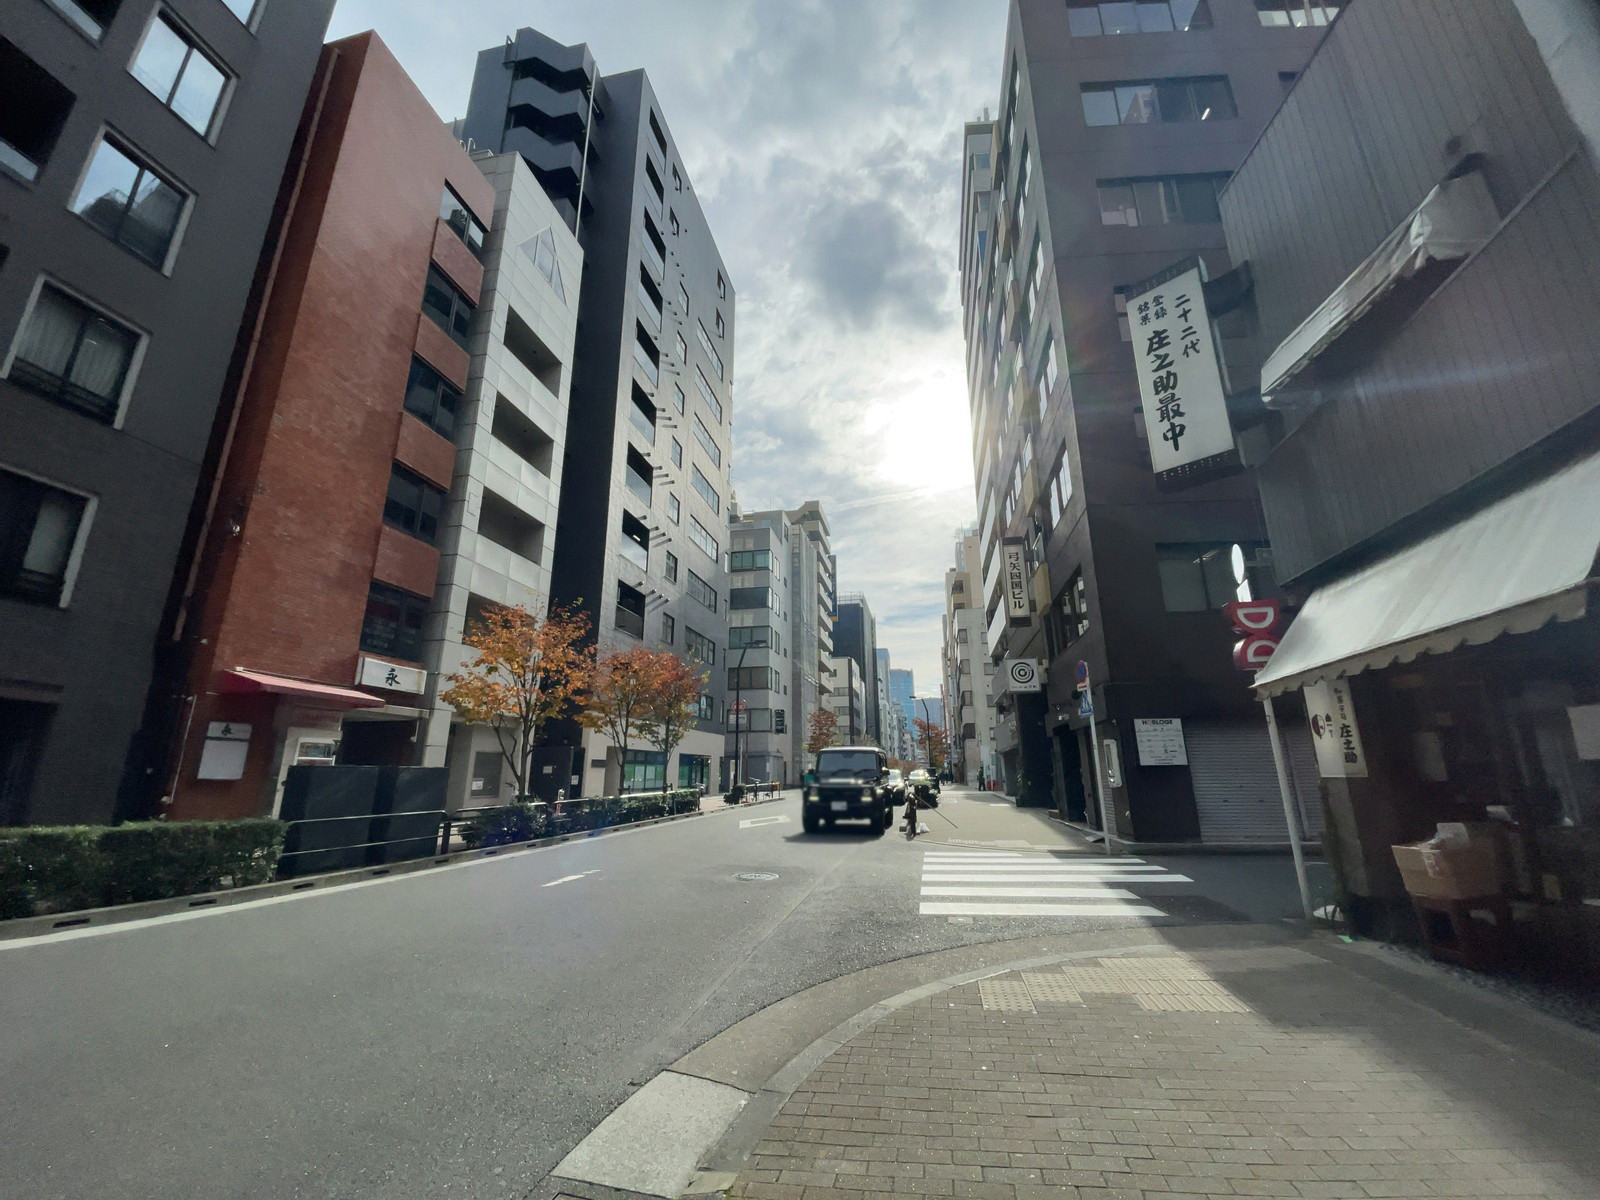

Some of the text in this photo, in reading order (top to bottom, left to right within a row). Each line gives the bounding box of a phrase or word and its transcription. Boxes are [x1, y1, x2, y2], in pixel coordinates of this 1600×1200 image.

[1174, 294, 1200, 358] 二十二代
[1146, 328, 1187, 452] 庄之助最中
[1008, 552, 1025, 610] 弓矢四国ビル
[385, 667, 401, 687] 永
